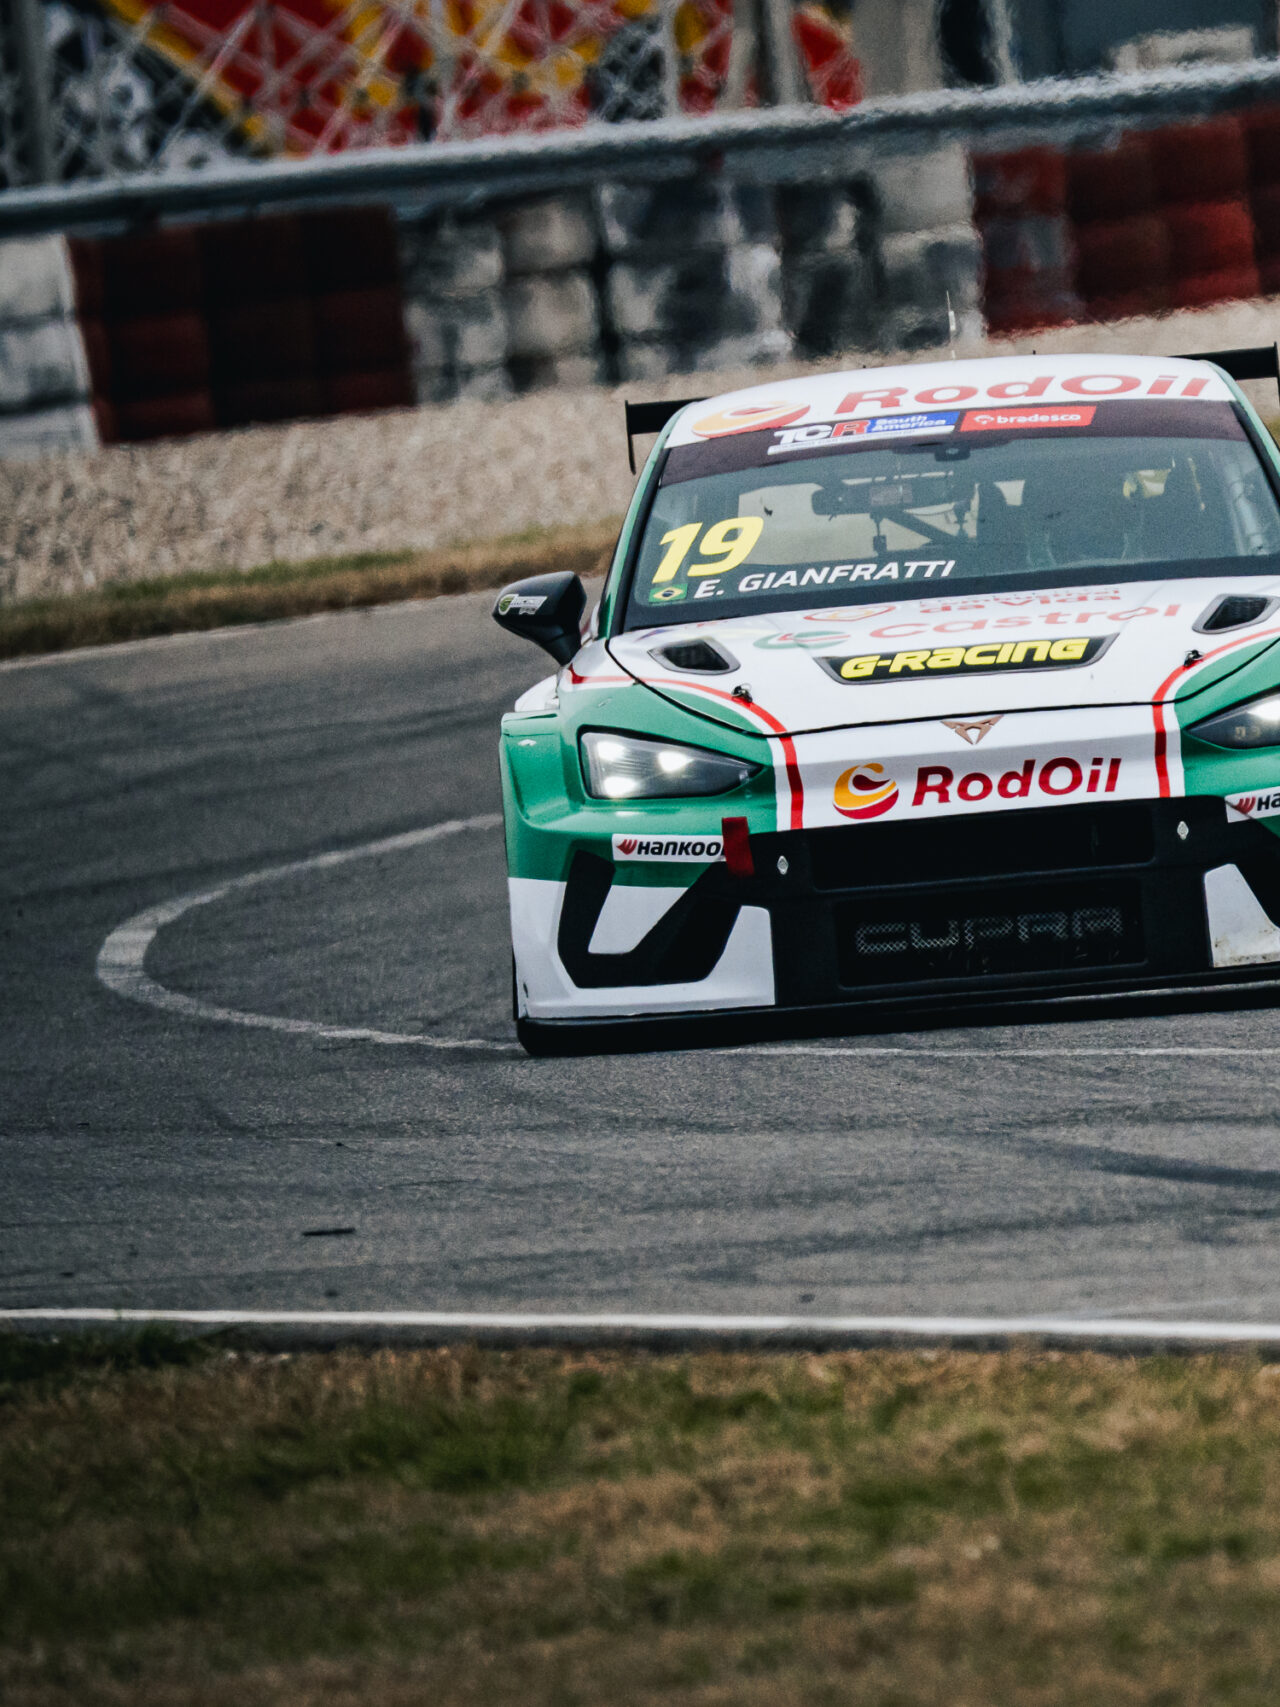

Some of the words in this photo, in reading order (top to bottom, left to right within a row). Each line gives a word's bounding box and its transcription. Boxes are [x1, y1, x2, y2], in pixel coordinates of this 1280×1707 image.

[834, 374, 1211, 415] RodOil
[773, 419, 871, 446] TCR
[872, 418, 947, 433] America
[875, 415, 928, 425] South
[996, 412, 1082, 425] bradesco
[651, 516, 764, 585] 19
[693, 579, 725, 599] E.
[738, 560, 956, 592] GIANFRATTI
[869, 604, 1182, 638] Castrol
[911, 757, 1122, 807] RodOil
[637, 841, 725, 856] HANKOO
[856, 907, 1124, 954] CUPRA
